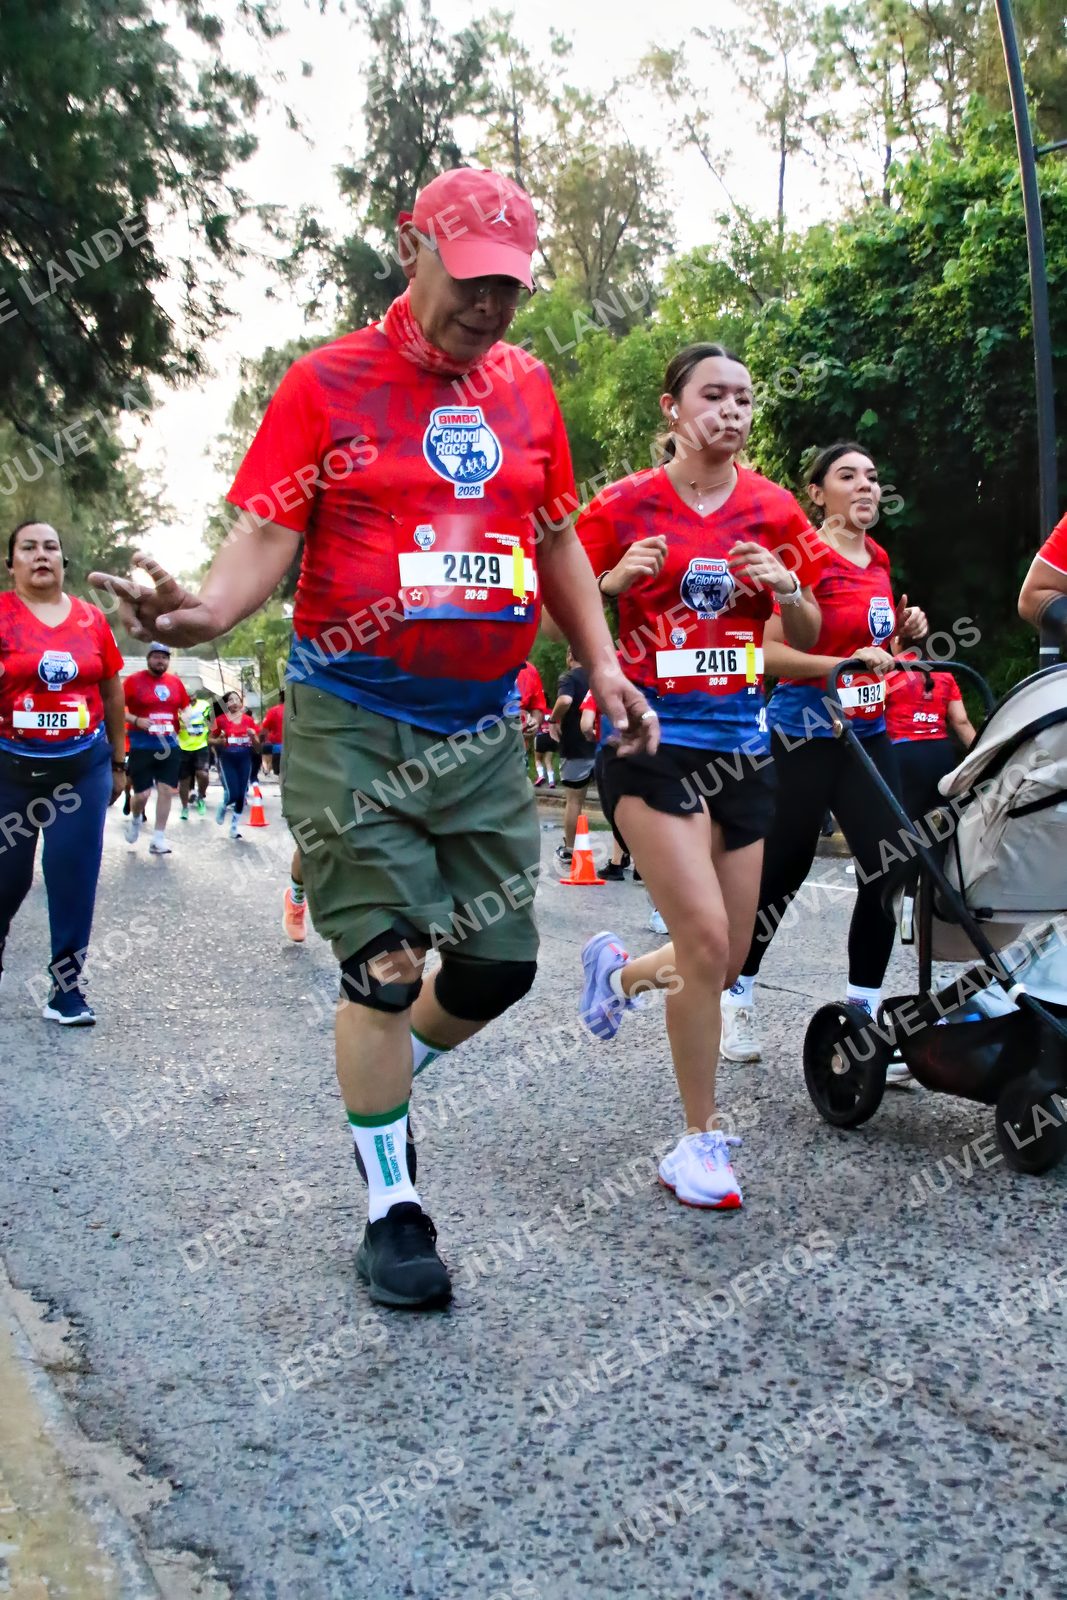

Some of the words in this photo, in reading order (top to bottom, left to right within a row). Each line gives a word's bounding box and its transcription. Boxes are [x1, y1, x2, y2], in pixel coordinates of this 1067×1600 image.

[438, 414, 478, 425] BIMBO
[441, 429, 480, 443] Global
[435, 442, 468, 455] Race
[457, 485, 481, 496] 2026
[442, 554, 501, 585] 2429
[694, 564, 724, 572] BIMBO
[695, 574, 723, 585] Global
[695, 649, 737, 673] 2416
[857, 684, 881, 704] 1932
[37, 713, 68, 728] 3126
